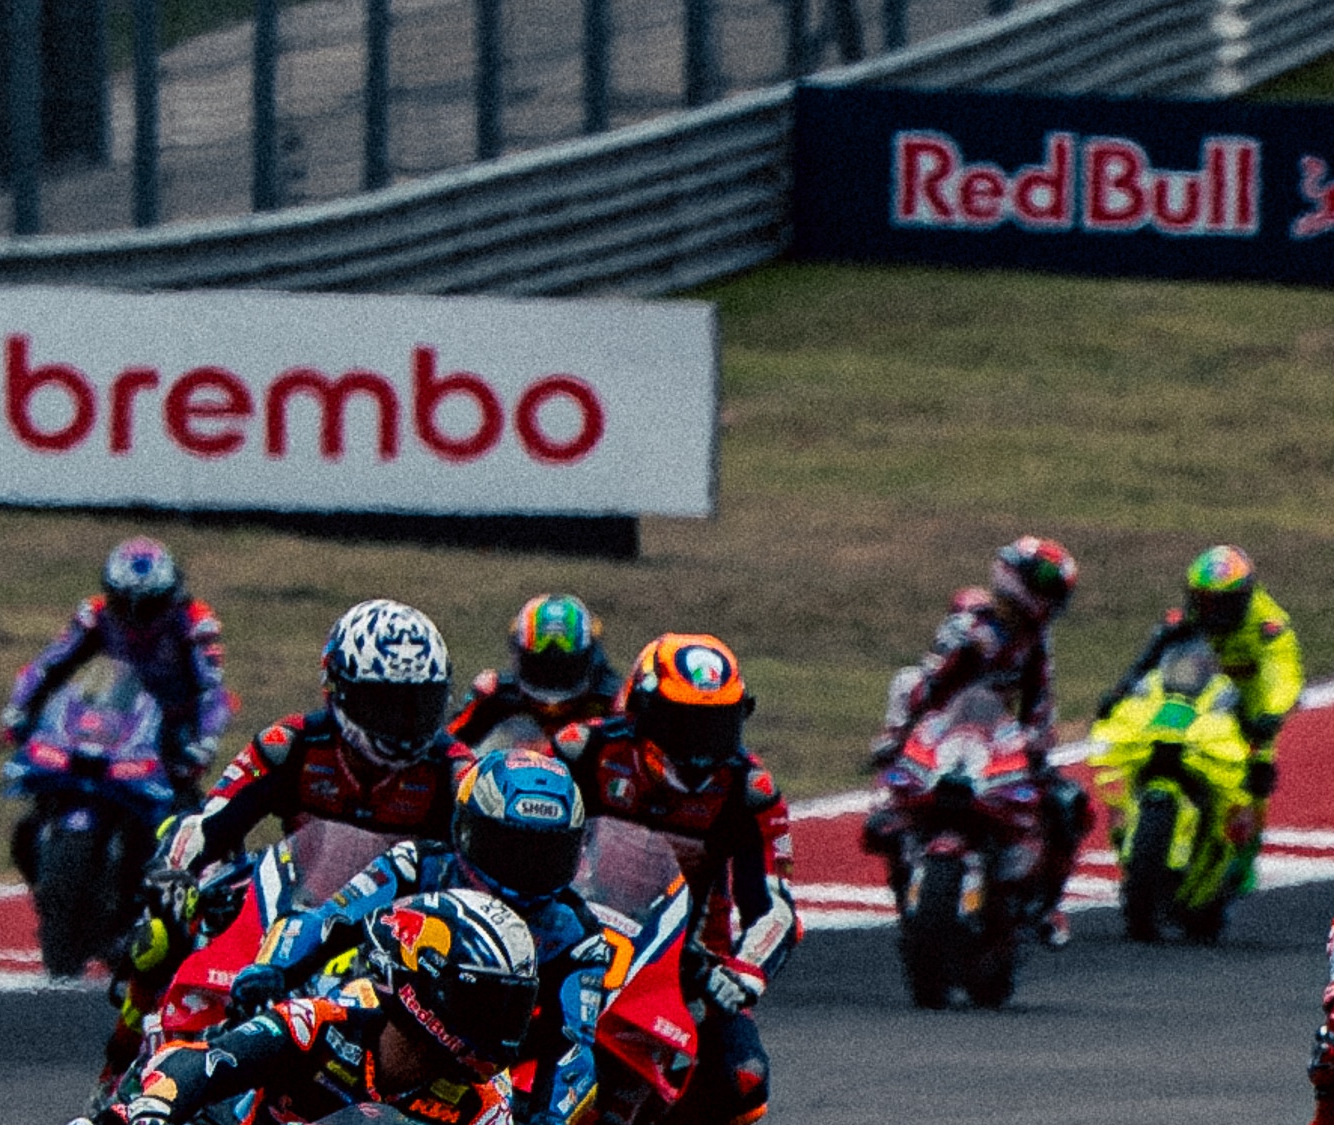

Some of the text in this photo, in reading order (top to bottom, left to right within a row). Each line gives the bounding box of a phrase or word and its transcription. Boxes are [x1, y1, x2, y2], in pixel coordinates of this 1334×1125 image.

[893, 129, 1262, 237] Red Bull
[4, 333, 605, 466] brembo
